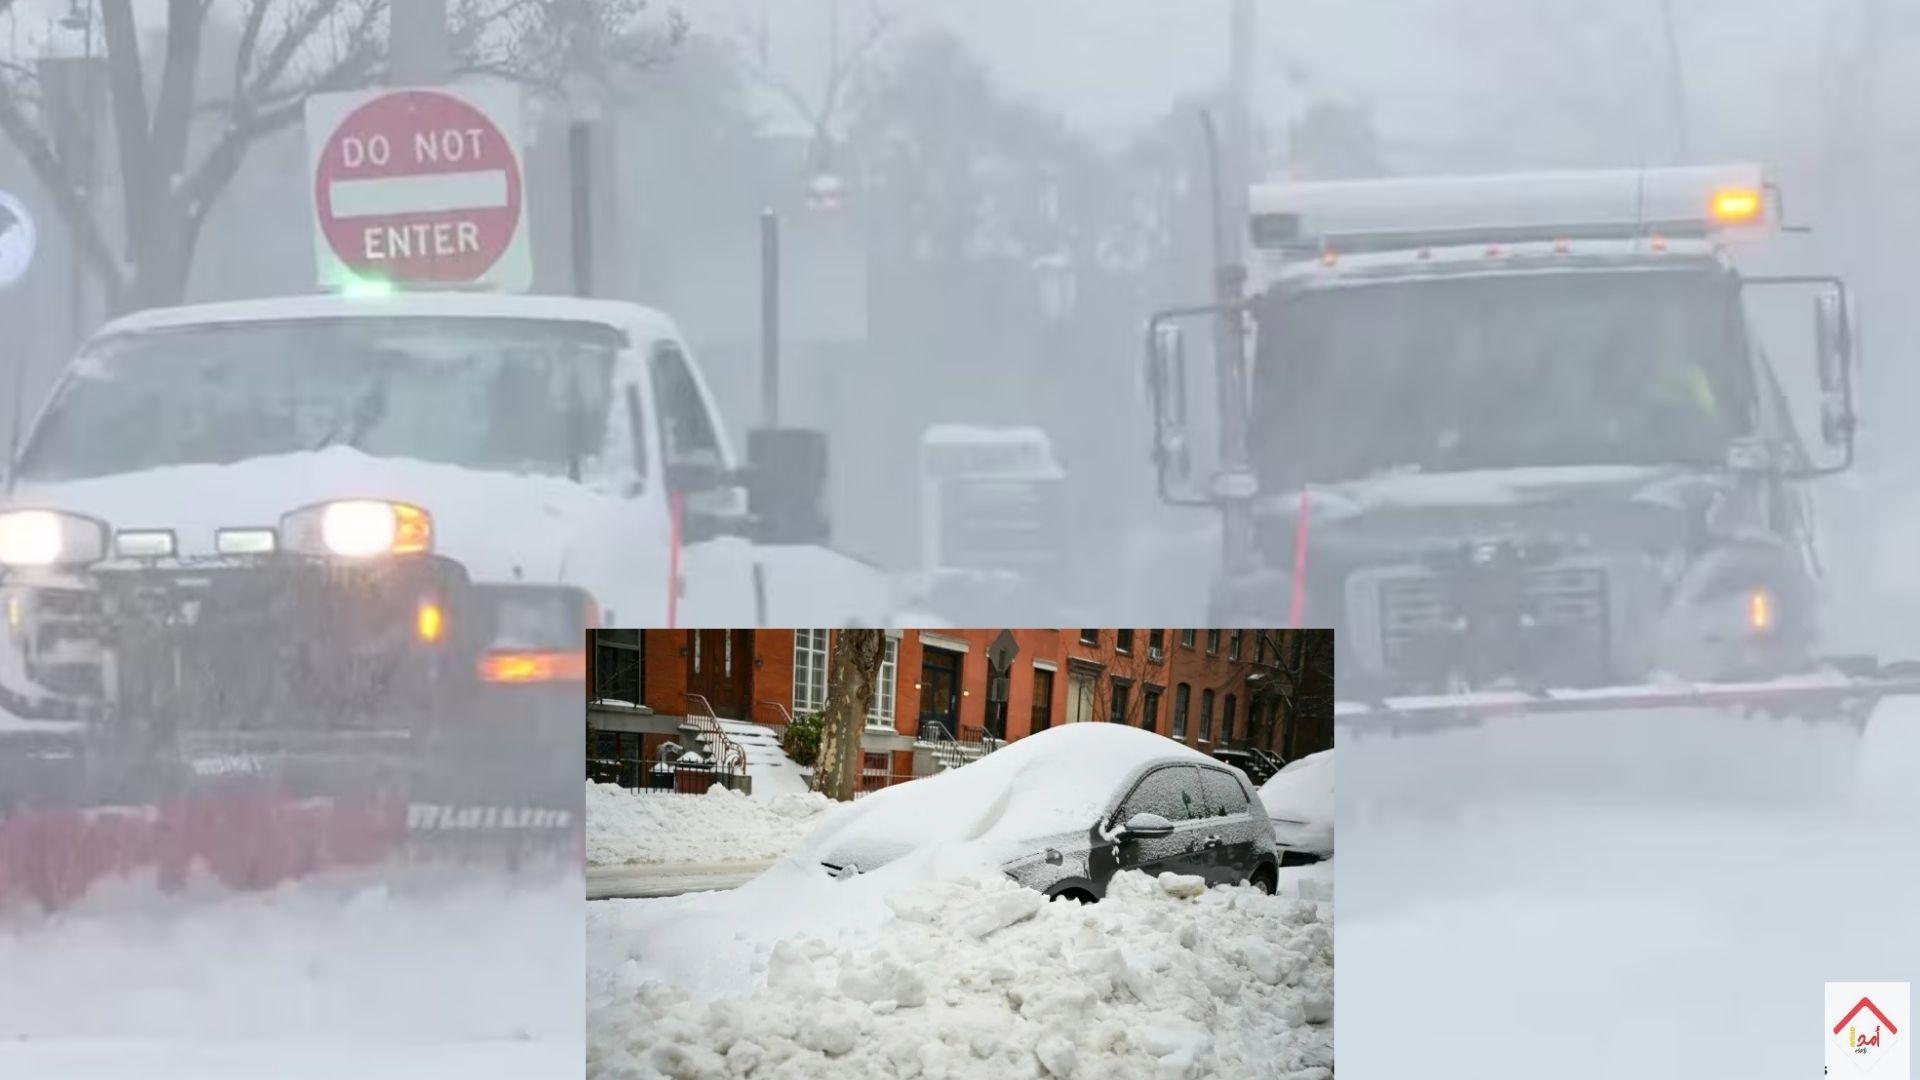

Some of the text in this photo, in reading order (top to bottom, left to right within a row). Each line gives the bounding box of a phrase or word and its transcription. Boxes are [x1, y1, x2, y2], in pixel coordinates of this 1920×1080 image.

[342, 128, 484, 168] DO NOT
[364, 221, 480, 259] ENTER
